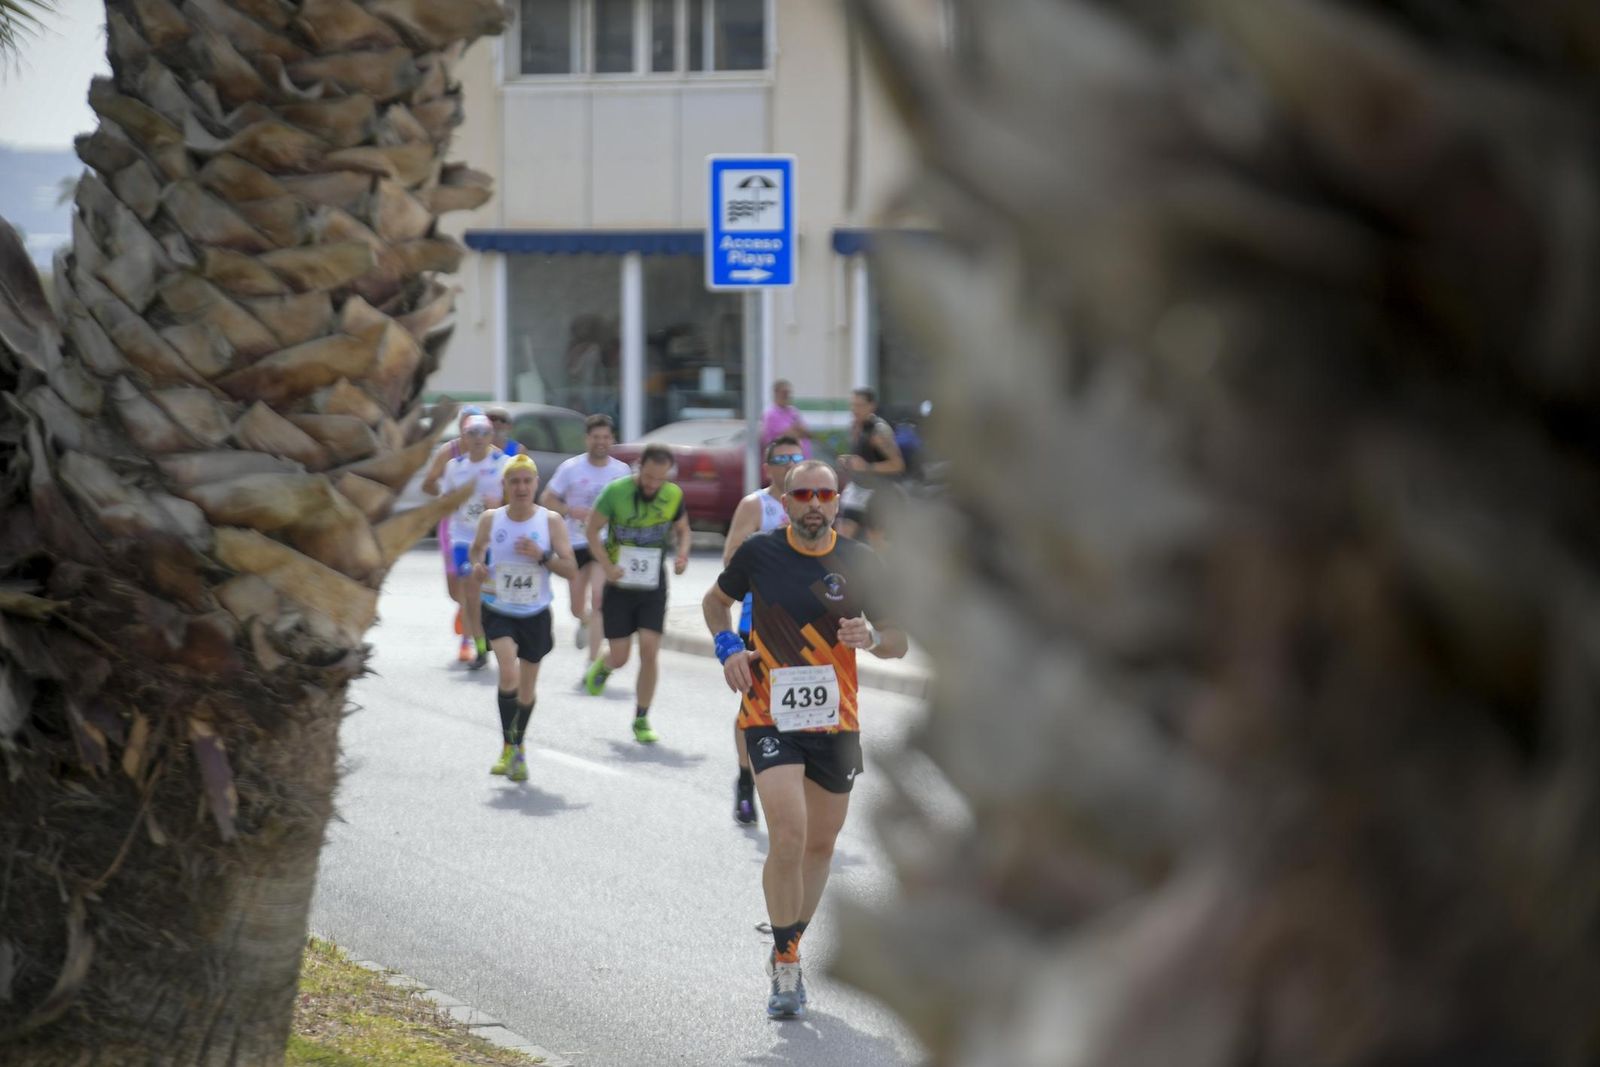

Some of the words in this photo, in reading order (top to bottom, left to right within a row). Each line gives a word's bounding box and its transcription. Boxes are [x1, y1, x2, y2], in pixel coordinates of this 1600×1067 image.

[720, 235, 783, 250] Acceso
[727, 250, 776, 267] Playa
[630, 559, 649, 572] 33
[504, 574, 533, 589] 744
[781, 685, 828, 709] 439
